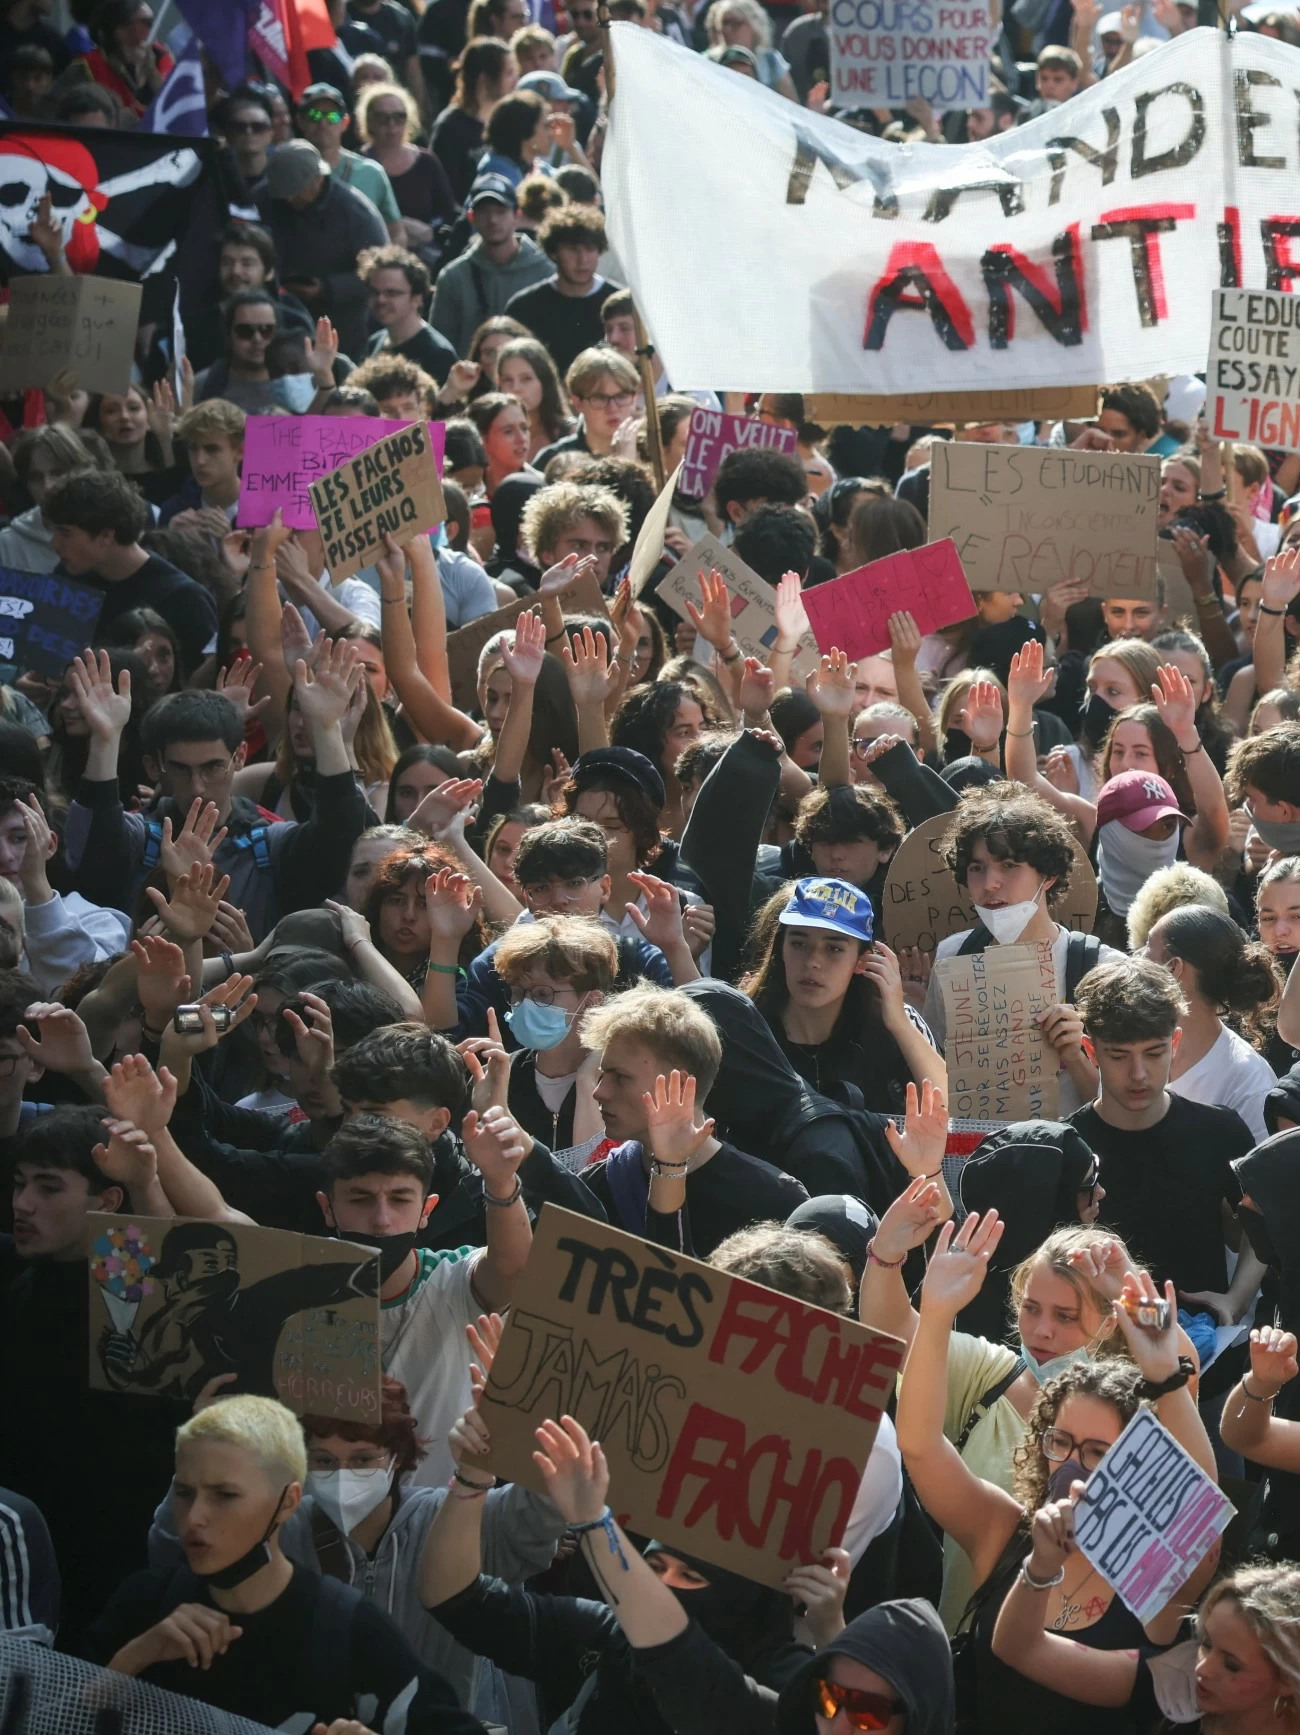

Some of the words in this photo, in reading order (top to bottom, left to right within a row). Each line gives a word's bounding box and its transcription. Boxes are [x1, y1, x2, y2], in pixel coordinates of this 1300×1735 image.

[832, 0, 933, 33] COURS
[938, 8, 986, 29] POUR
[834, 33, 896, 61] VOUS
[902, 35, 988, 61] DONNER
[837, 66, 877, 94] UNE
[1218, 326, 1289, 358] COUTE
[258, 421, 303, 447] THE
[685, 438, 709, 471] LE
[692, 409, 721, 438] ON
[734, 419, 794, 455] VEUT
[312, 470, 350, 516] LES
[351, 427, 426, 491] FACHOS
[943, 446, 1024, 495] LES
[1039, 451, 1161, 502] ÉTUDIANTS
[321, 508, 346, 542] JE
[350, 468, 405, 521] LEURS
[328, 519, 377, 568] PISSE
[376, 506, 399, 541] AU
[400, 496, 418, 522] Q
[1142, 780, 1166, 799] NY
[890, 879, 931, 904] DES
[951, 978, 973, 1067] JEUNE
[972, 953, 991, 1043] RÉVOLTER
[993, 983, 1009, 1049] ASSEZ
[976, 1047, 990, 1069] SE
[1010, 999, 1026, 1087] GRAND
[1029, 1049, 1044, 1078] SE
[556, 1237, 713, 1348] TRÈS
[707, 1277, 905, 1423] FACHÉ
[655, 1402, 861, 1567] FACHO
[1073, 1470, 1128, 1551] PAS
[1098, 1514, 1152, 1580] LES
